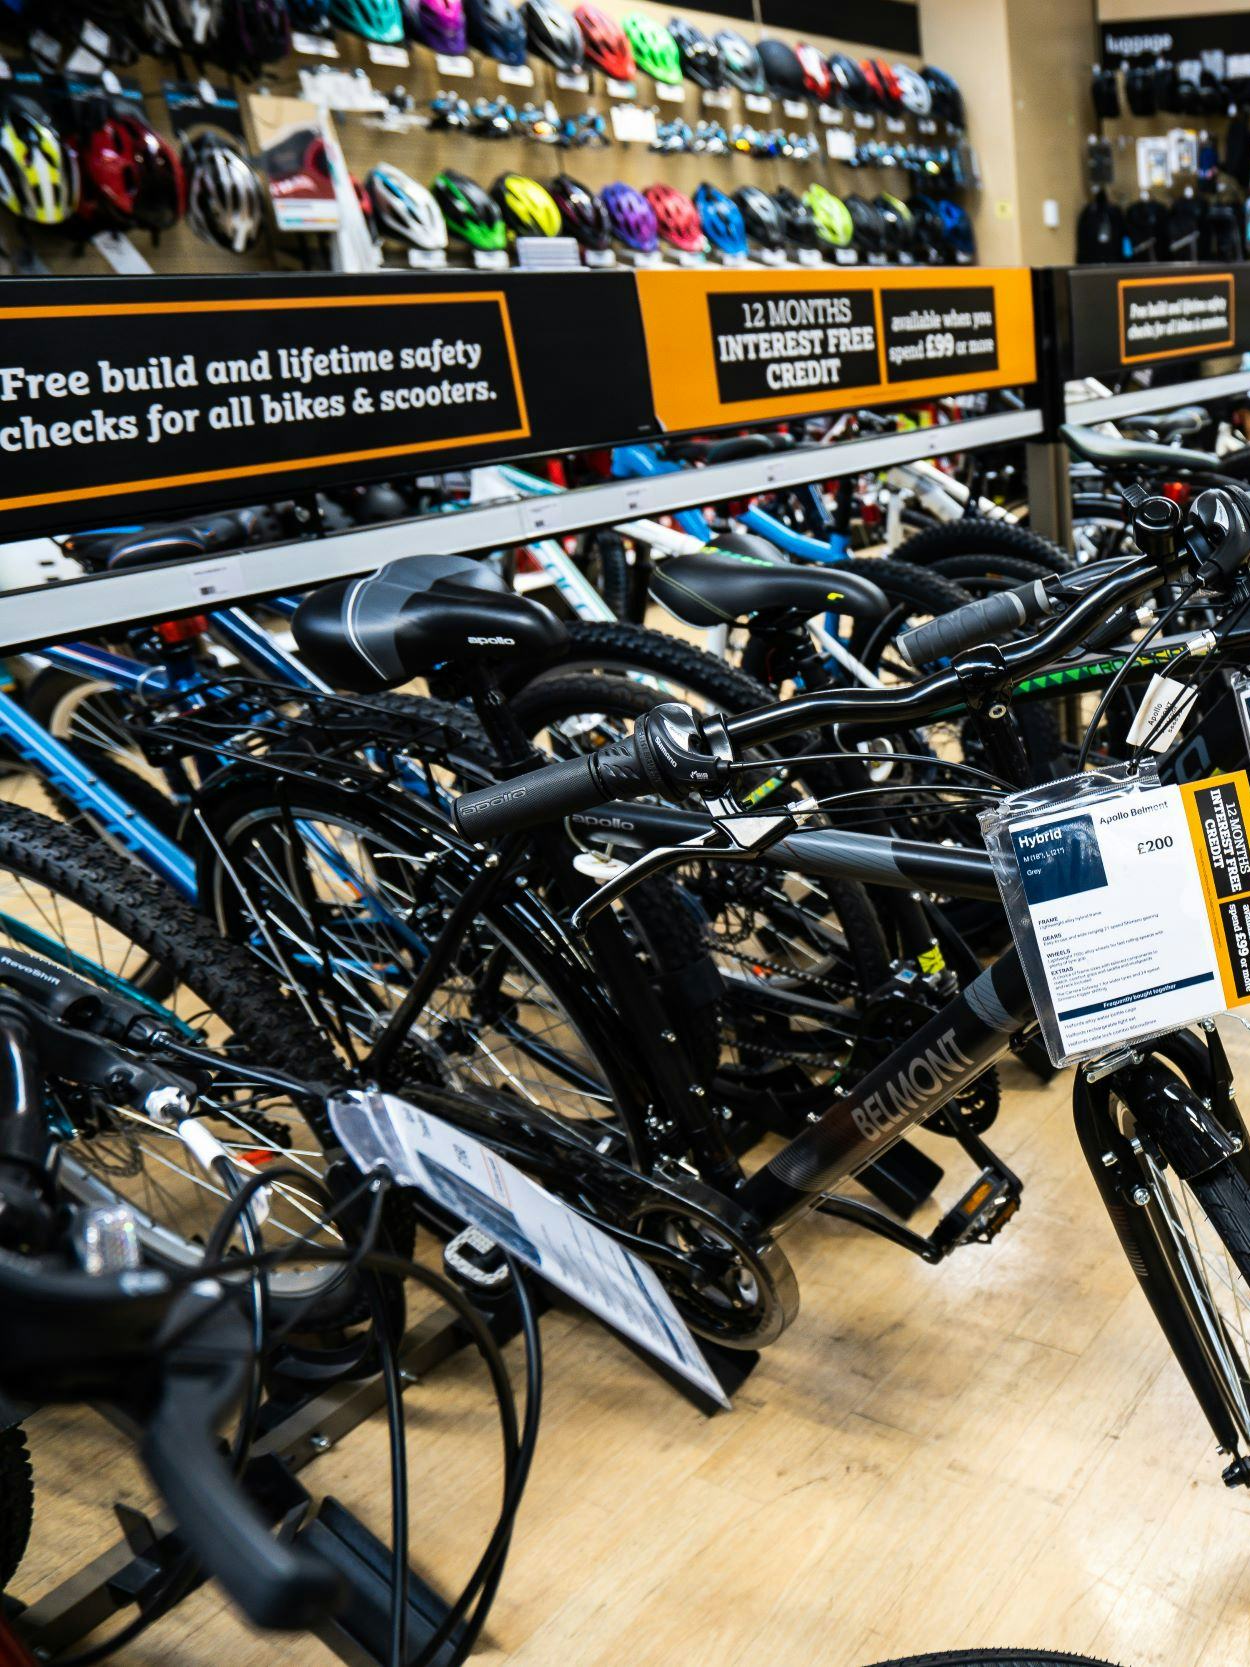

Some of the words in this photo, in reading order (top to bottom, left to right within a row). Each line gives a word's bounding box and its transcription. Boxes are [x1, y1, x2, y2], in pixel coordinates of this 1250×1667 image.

[1105, 33, 1173, 54] luggage
[741, 303, 765, 329] 12
[768, 297, 852, 328] MONTHS
[891, 308, 942, 333] available
[942, 307, 973, 329] when
[972, 309, 992, 329] you
[717, 329, 825, 362] INTEREST
[826, 325, 876, 354] FREE
[888, 341, 925, 366] spend
[925, 332, 955, 358] £99
[955, 341, 970, 356] or
[968, 337, 994, 355] more
[0, 367, 91, 401] Free
[97, 354, 199, 393] build
[206, 350, 273, 385] and
[278, 344, 394, 384] lifetime
[400, 337, 482, 373] safety
[766, 357, 841, 390] CREDIT
[0, 409, 139, 452] checks
[147, 403, 200, 443] for
[207, 395, 255, 430] all
[261, 391, 346, 424] bikes
[352, 386, 375, 414] &
[380, 379, 498, 412] scooters.
[467, 636, 516, 646] apollo
[1147, 702, 1163, 728] Apollo
[653, 735, 679, 769] SHIMANO
[460, 786, 526, 816] apollo
[1099, 810, 1129, 826] Apollo
[1130, 800, 1168, 816] Belmont
[1225, 802, 1237, 817] 12
[572, 813, 634, 831] apollo
[1018, 827, 1062, 850] Hybrid
[1136, 835, 1173, 854] £200
[1204, 818, 1224, 869] CREDIT
[1210, 788, 1233, 855] INTEREST
[1225, 858, 1241, 892] FREE
[1229, 817, 1250, 874] MONTHS
[1026, 867, 1041, 876] Grey
[1038, 916, 1057, 925] FRAME
[1228, 903, 1242, 932] spend
[1042, 932, 1062, 941] GEARS
[1234, 931, 1249, 956] £99
[1047, 948, 1070, 958] WHEELS
[1239, 958, 1248, 969] or
[1, 955, 61, 987] RevoShift
[1051, 966, 1073, 975] EXTRAS
[1103, 995, 1132, 1009] Frequently
[1133, 990, 1152, 1000] bought
[1153, 983, 1176, 994] together
[850, 1027, 975, 1142] BELMONT
